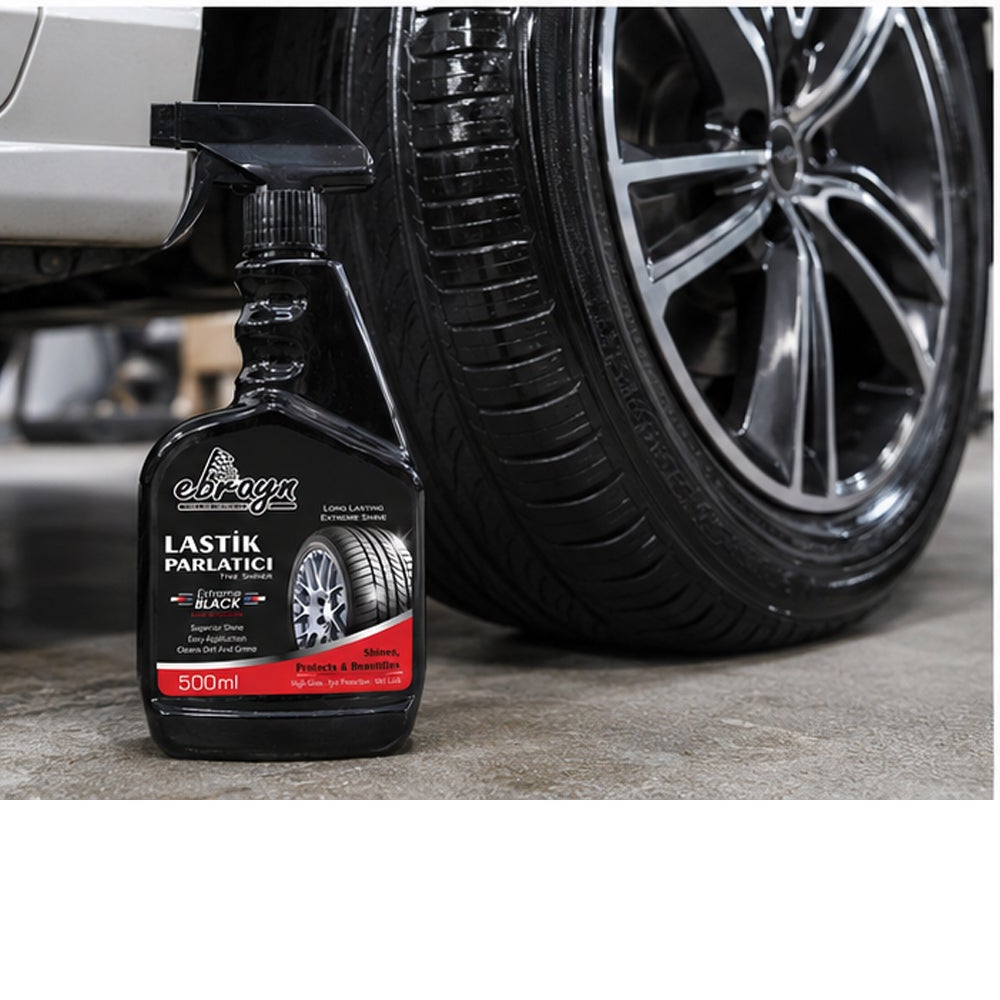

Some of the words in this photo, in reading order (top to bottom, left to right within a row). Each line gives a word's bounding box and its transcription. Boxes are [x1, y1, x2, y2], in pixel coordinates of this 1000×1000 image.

[173, 447, 299, 516] ebrayn
[165, 530, 260, 554] LASTİK
[165, 557, 273, 572] PARLATICI
[194, 597, 241, 609] BLACK
[178, 675, 238, 691] 500ml
